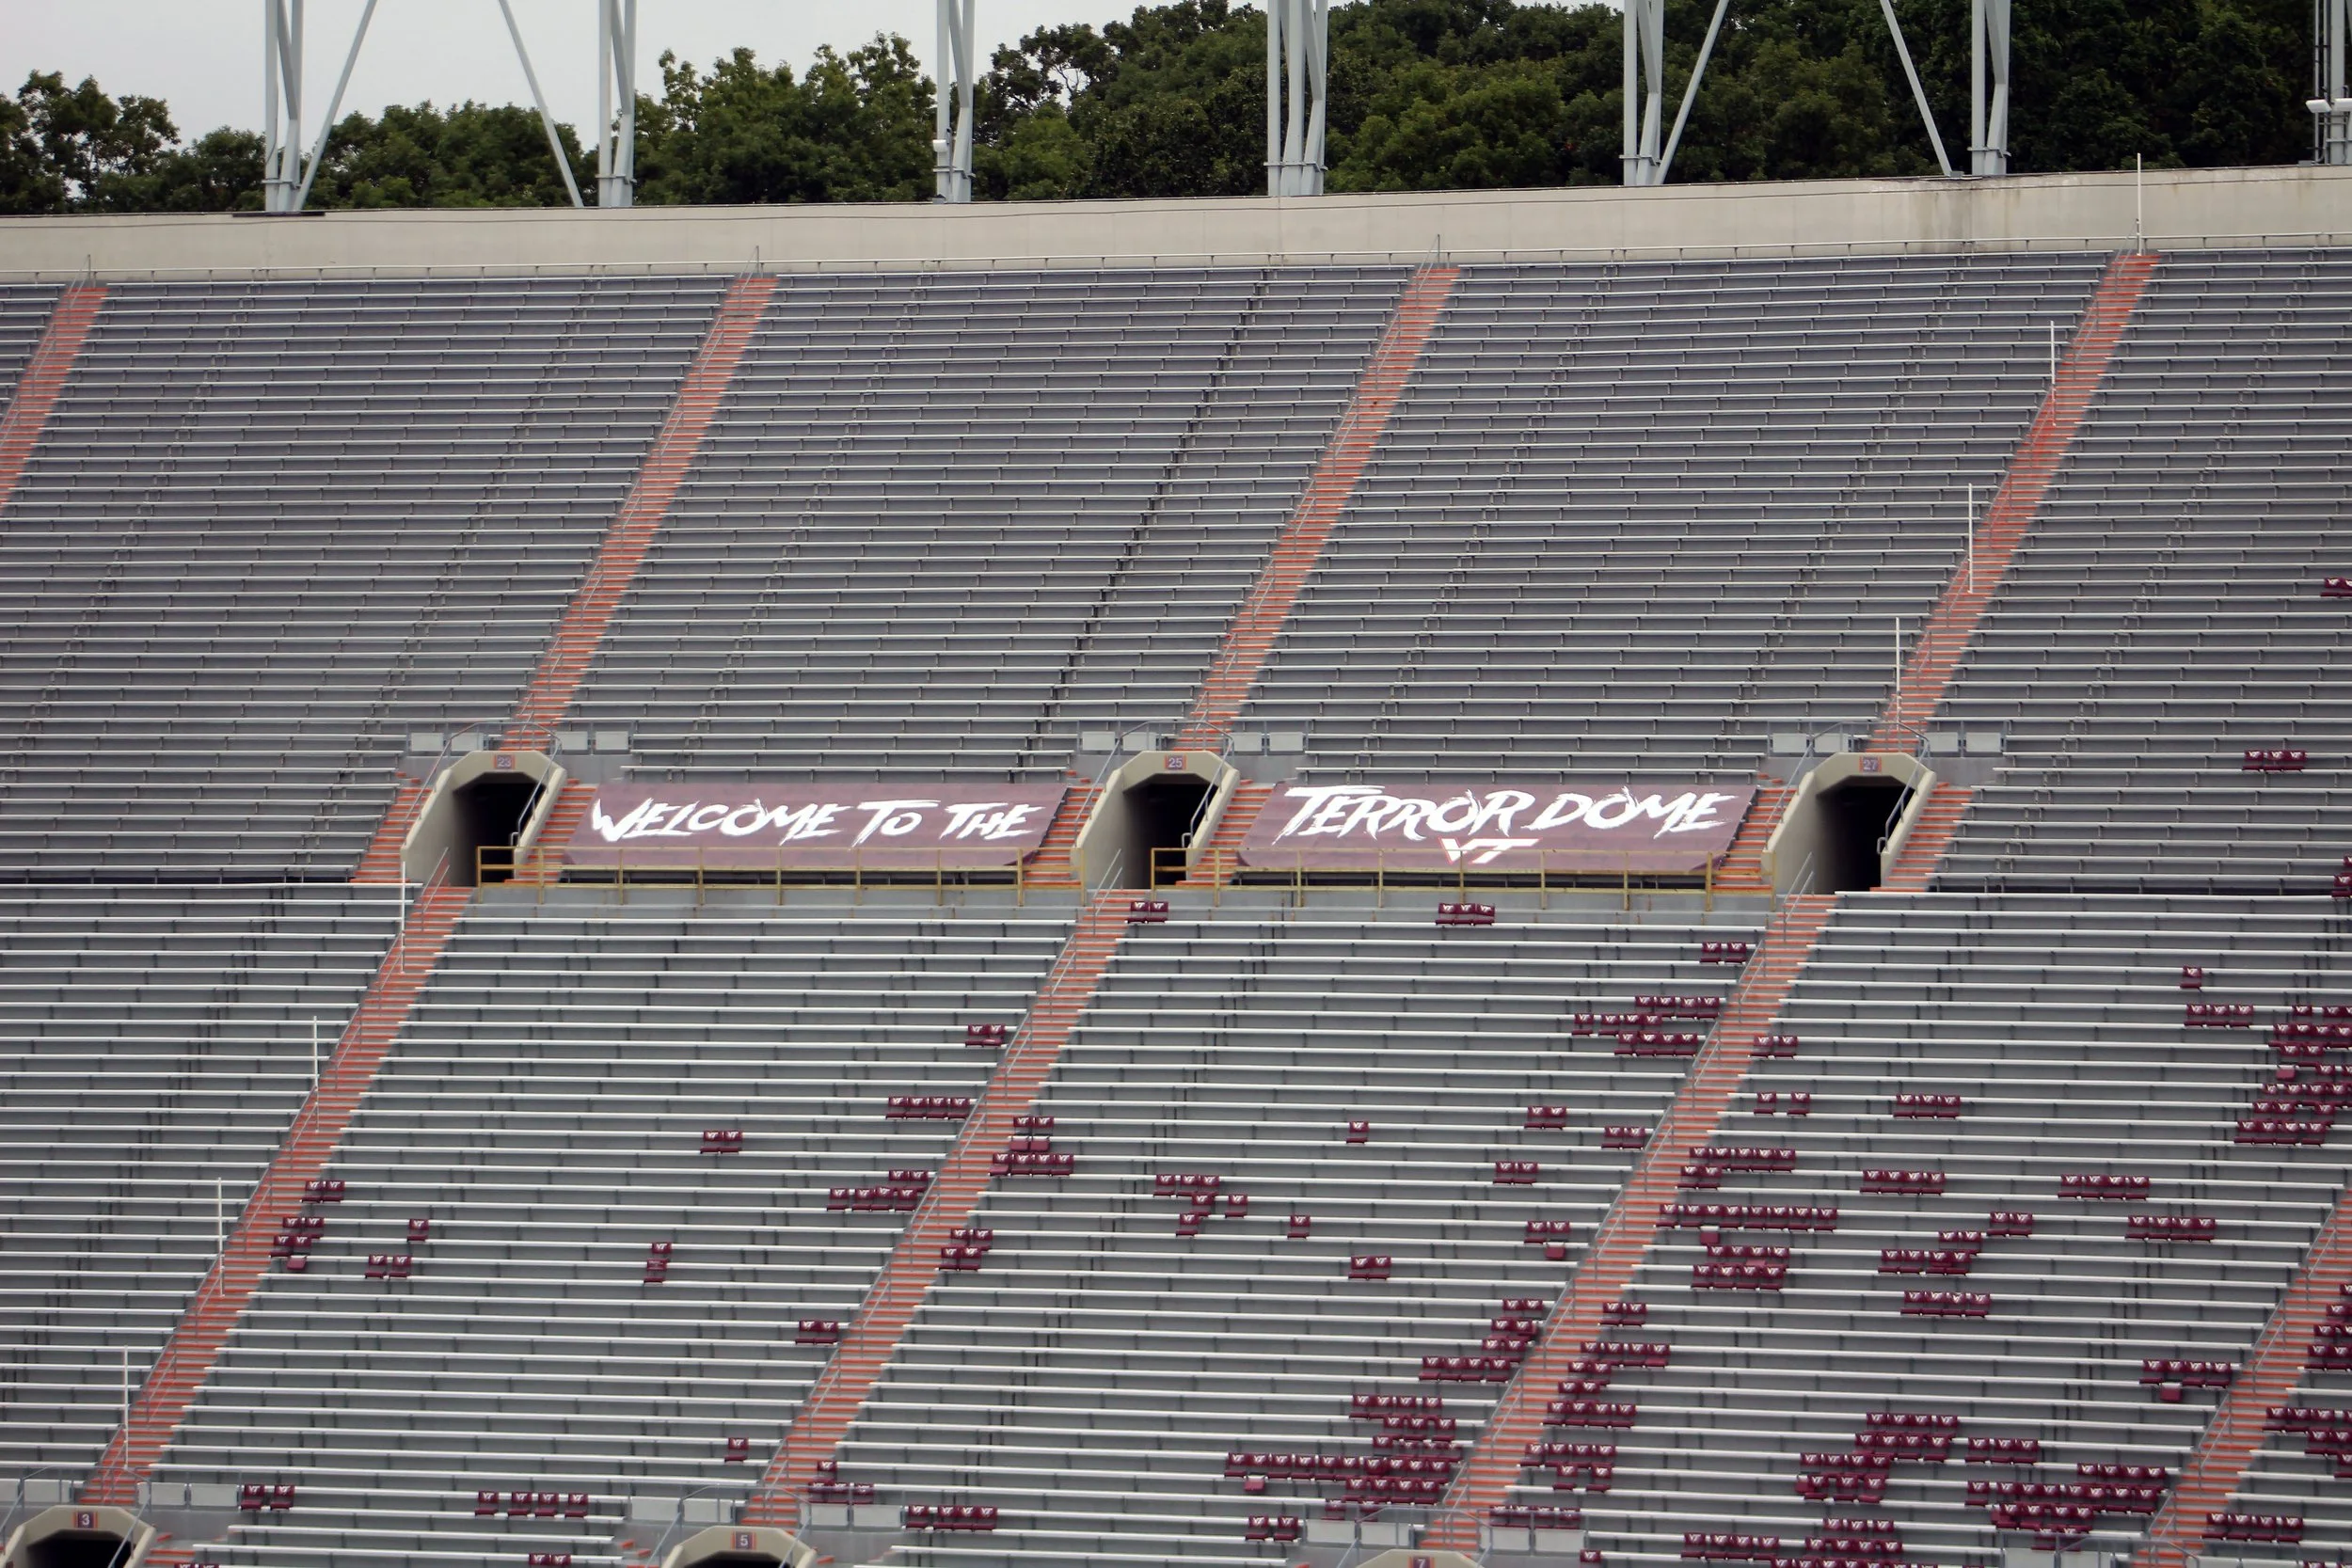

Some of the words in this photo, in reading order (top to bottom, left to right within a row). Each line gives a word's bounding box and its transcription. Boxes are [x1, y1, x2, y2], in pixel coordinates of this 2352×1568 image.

[498, 757, 512, 768] 23
[1168, 757, 1183, 768] 25
[1864, 759, 1878, 769] 27
[1272, 784, 1536, 846] TERROR
[1520, 785, 1738, 839] DOME
[593, 798, 853, 846] WELCOME
[850, 800, 941, 850] TO
[939, 802, 1045, 840] THE
[1438, 837, 1544, 865] VT
[82, 1513, 90, 1525] 3
[740, 1534, 749, 1546] 5
[1417, 1559, 1426, 1568] 7
